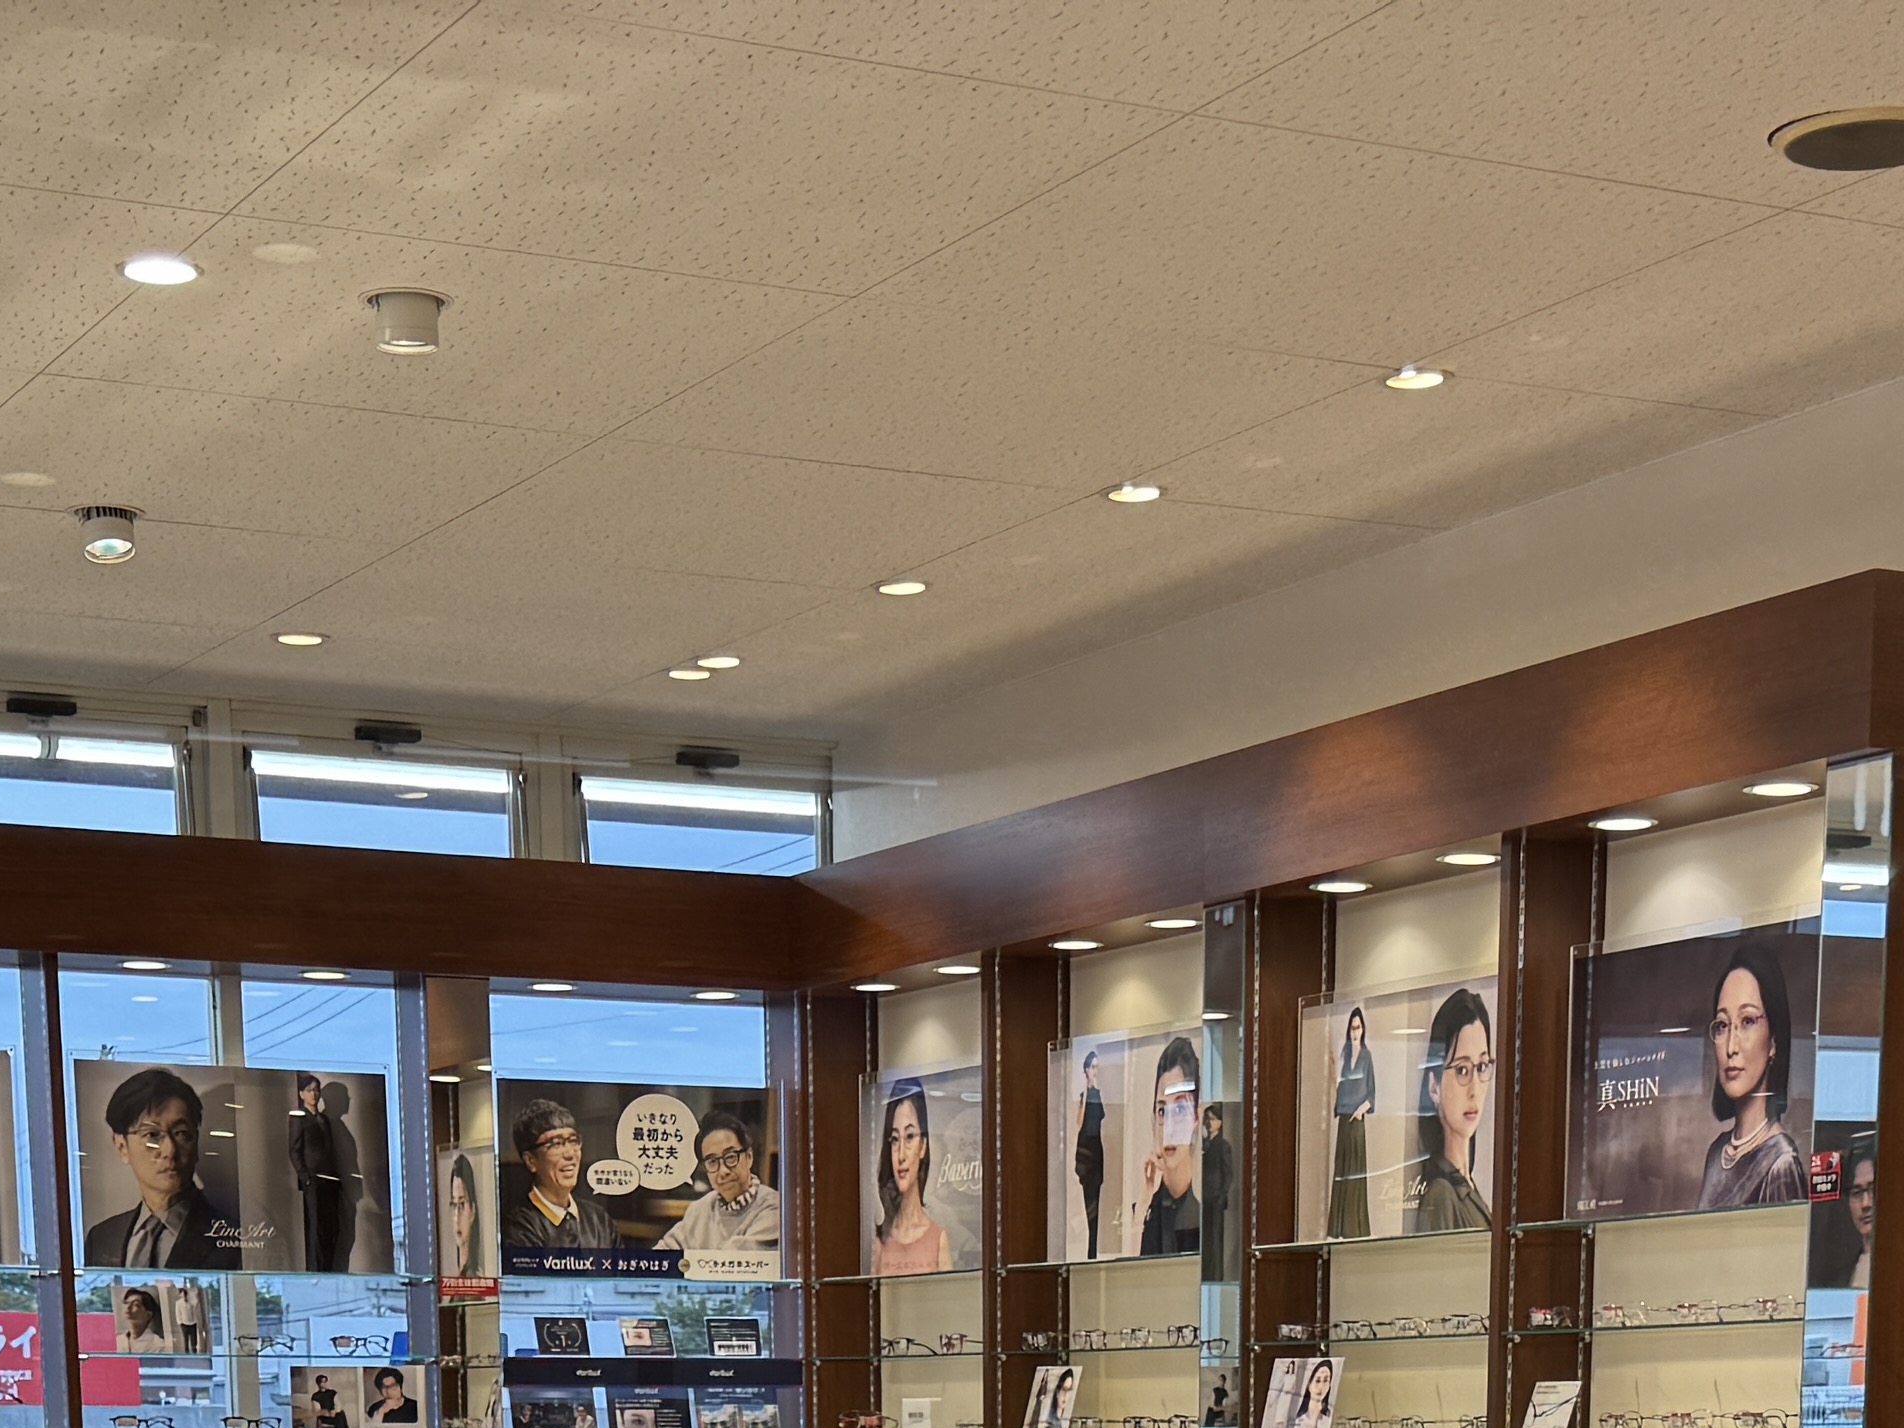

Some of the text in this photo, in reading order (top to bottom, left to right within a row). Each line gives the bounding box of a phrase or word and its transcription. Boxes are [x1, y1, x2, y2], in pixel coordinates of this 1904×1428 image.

[636, 1112, 678, 1125] いきなり
[632, 1127, 684, 1143] 最初から
[637, 1145, 679, 1160] 大丈夫
[643, 1162, 674, 1175] だった
[203, 1217, 278, 1240] Line Art
[215, 1239, 266, 1249] CHARMANT
[617, 1259, 670, 1271] おぎやはぎ
